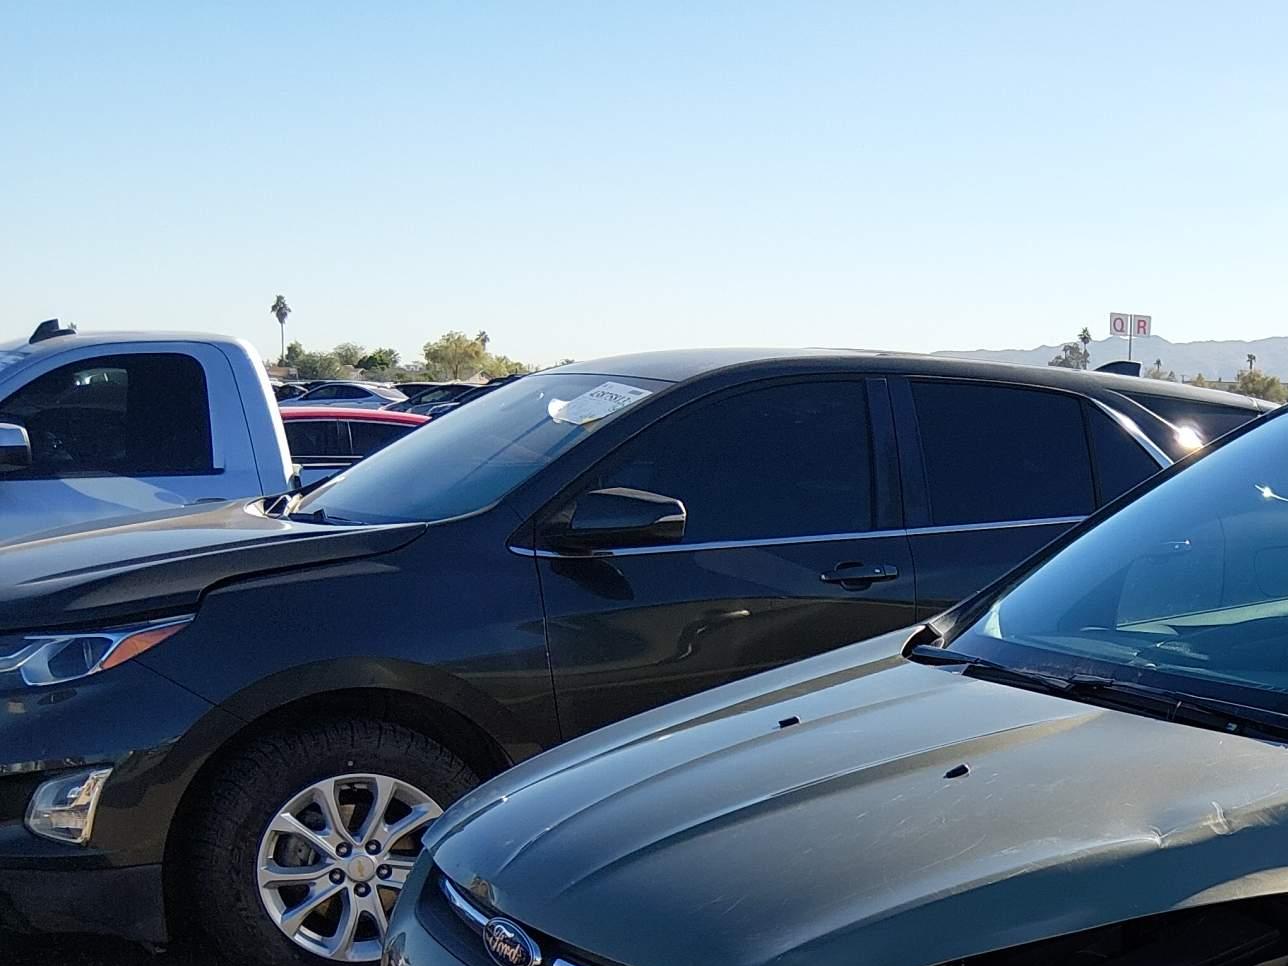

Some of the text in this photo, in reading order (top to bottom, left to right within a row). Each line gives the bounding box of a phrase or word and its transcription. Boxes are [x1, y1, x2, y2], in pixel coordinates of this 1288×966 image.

[1113, 317, 1125, 333] Q
[1136, 319, 1147, 335] R
[488, 925, 523, 964] Ford
